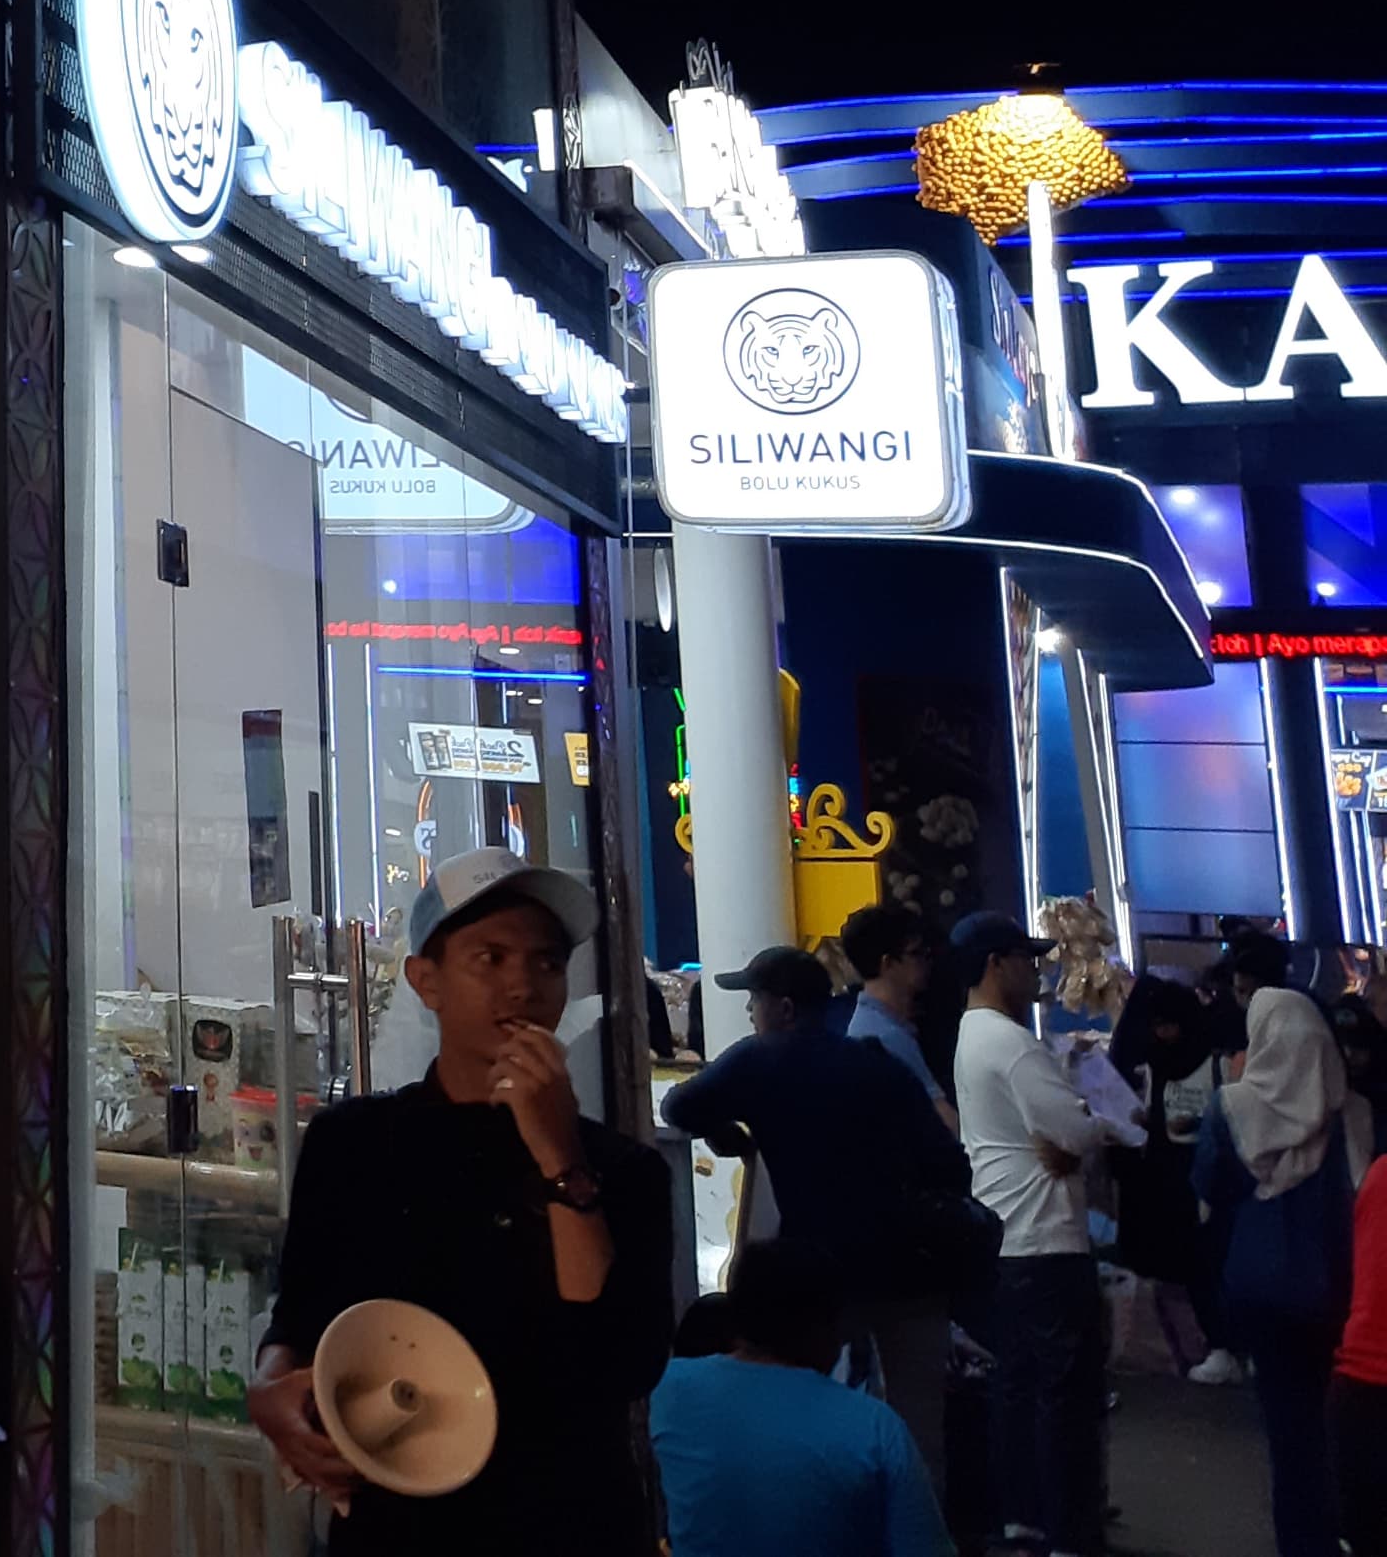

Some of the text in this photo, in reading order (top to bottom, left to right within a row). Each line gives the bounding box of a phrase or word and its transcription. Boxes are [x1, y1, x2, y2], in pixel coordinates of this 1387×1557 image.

[690, 430, 911, 464] SILIWANGI
[740, 475, 861, 490] BOLU KUKUS
